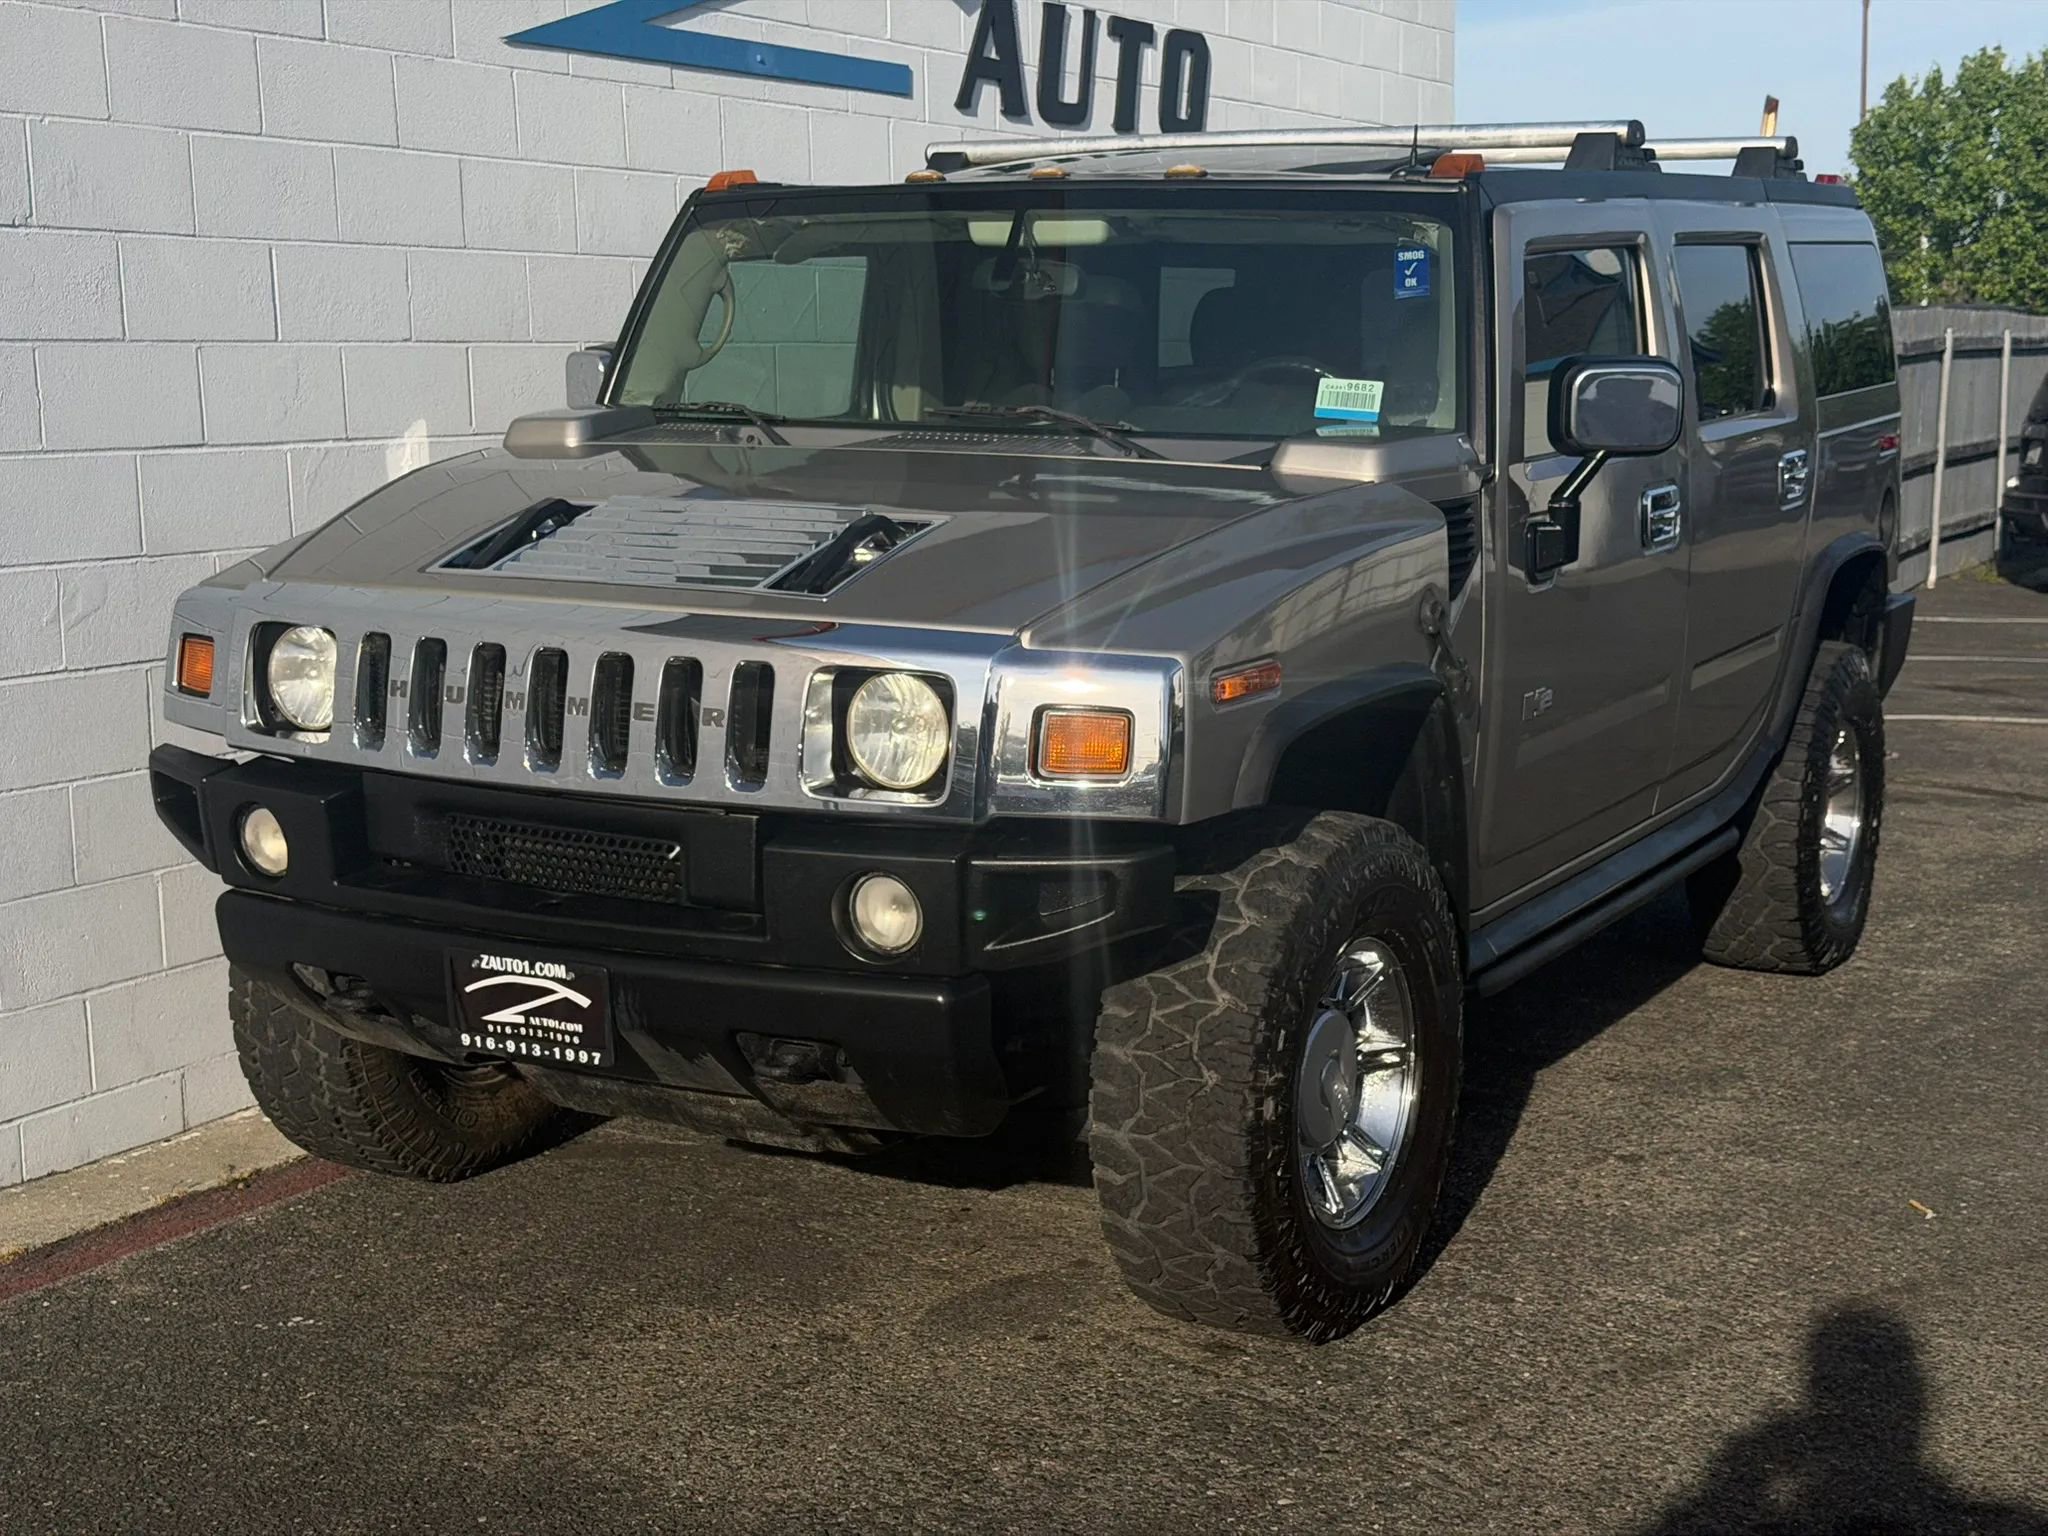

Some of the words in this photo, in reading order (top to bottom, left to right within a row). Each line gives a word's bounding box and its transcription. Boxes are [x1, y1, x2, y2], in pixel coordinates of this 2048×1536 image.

[954, 0, 1211, 133] AUTO
[1397, 250, 1425, 261] SMOG
[1404, 277, 1418, 288] OK
[389, 679, 726, 729] HUMMER
[480, 953, 567, 979] ZAUTO1.COM
[487, 1024, 580, 1045] 916-913-1996
[528, 1016, 584, 1034] AUTO1.COM
[460, 1033, 602, 1065] 916-913-1997
